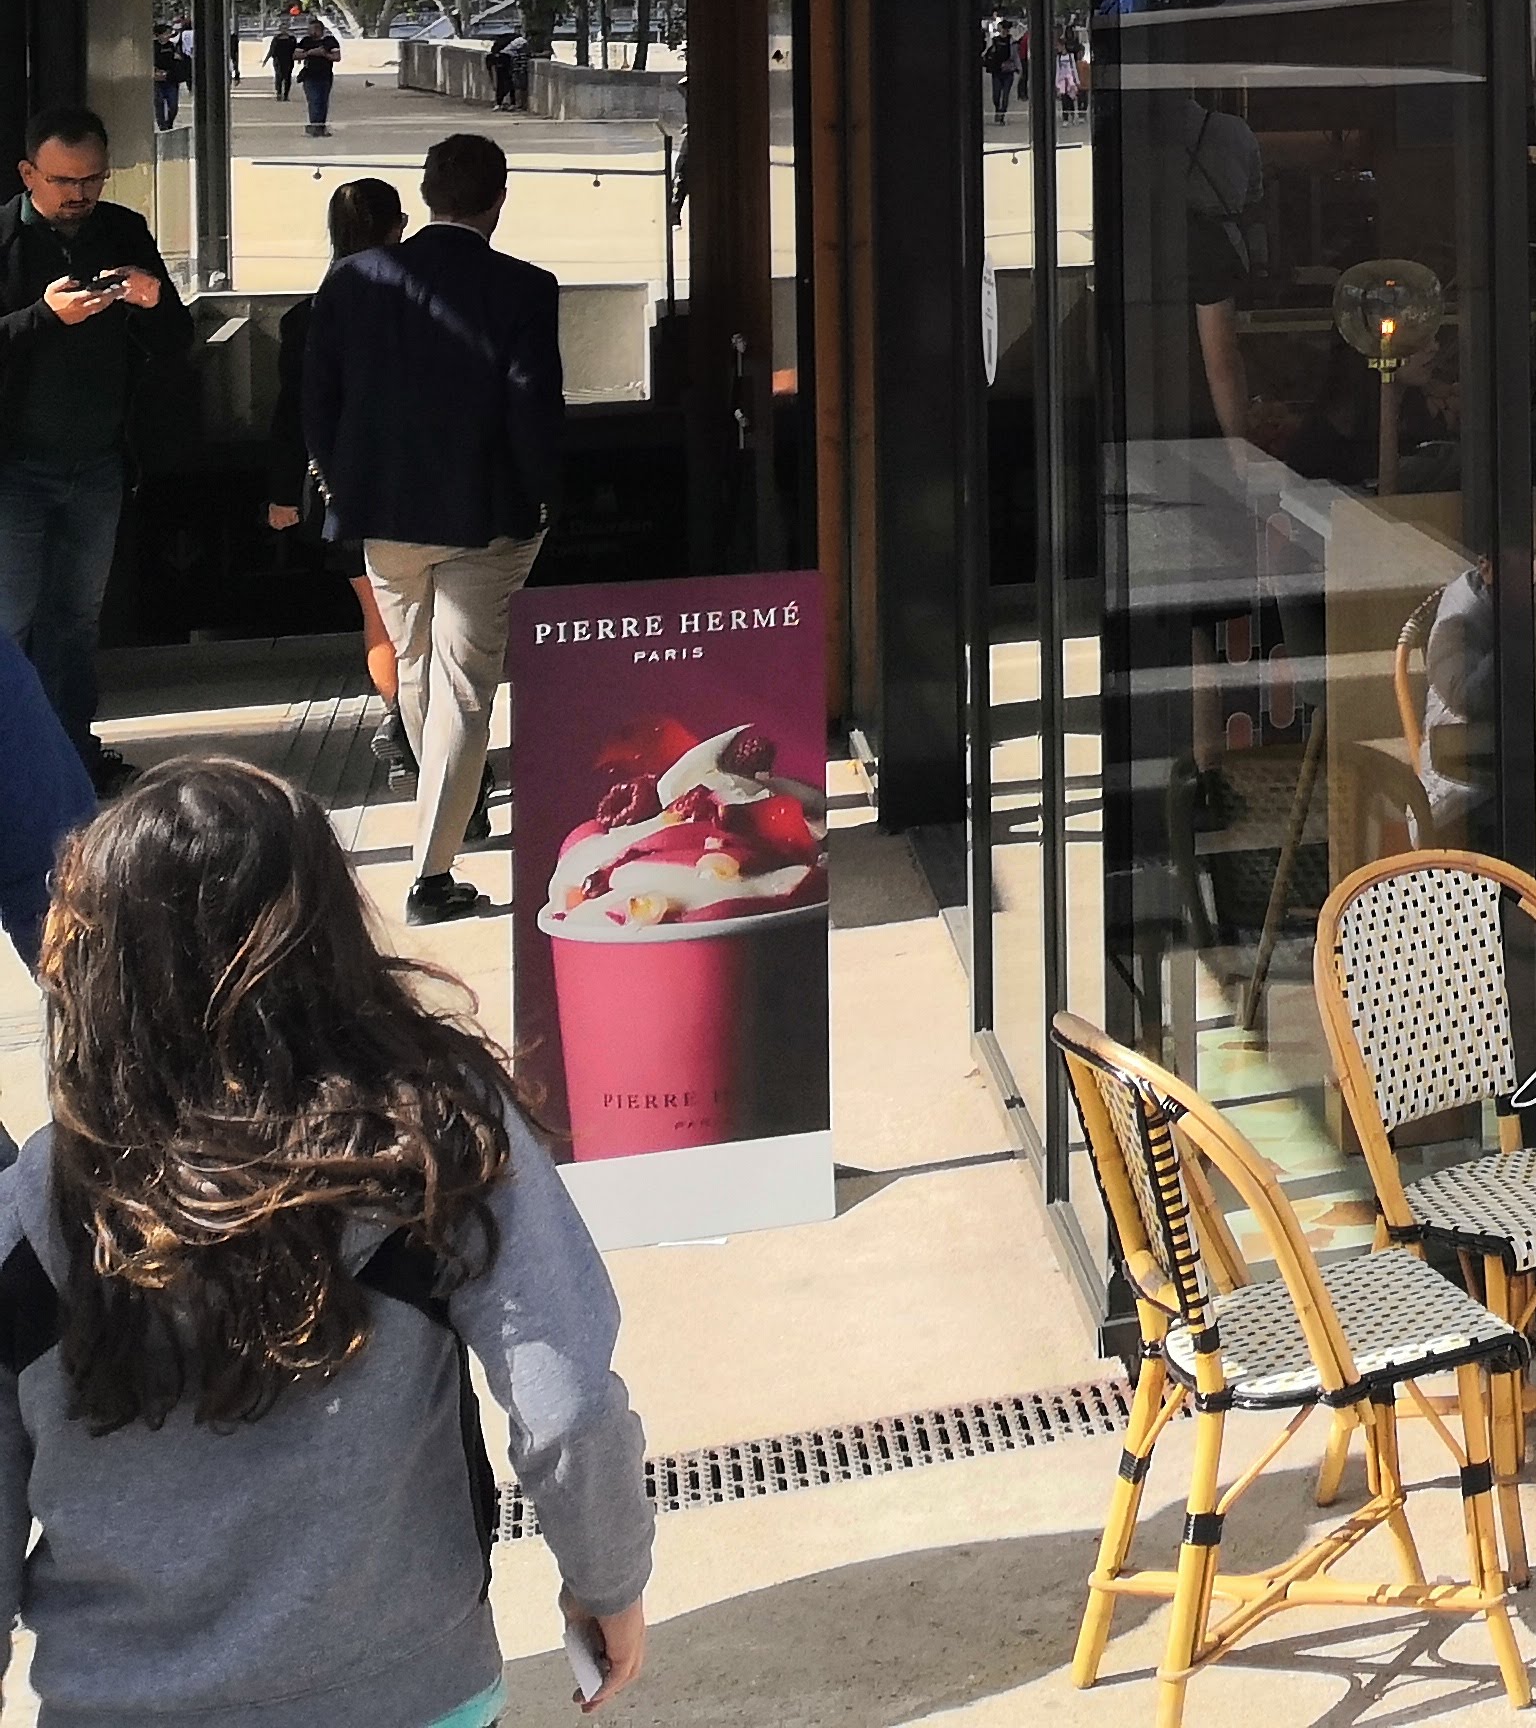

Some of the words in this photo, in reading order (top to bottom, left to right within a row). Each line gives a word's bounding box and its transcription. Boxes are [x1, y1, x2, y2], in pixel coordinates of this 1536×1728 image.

[535, 614, 665, 645] PIERRE
[679, 600, 800, 634] HERMÉ
[633, 646, 704, 664] PARIS
